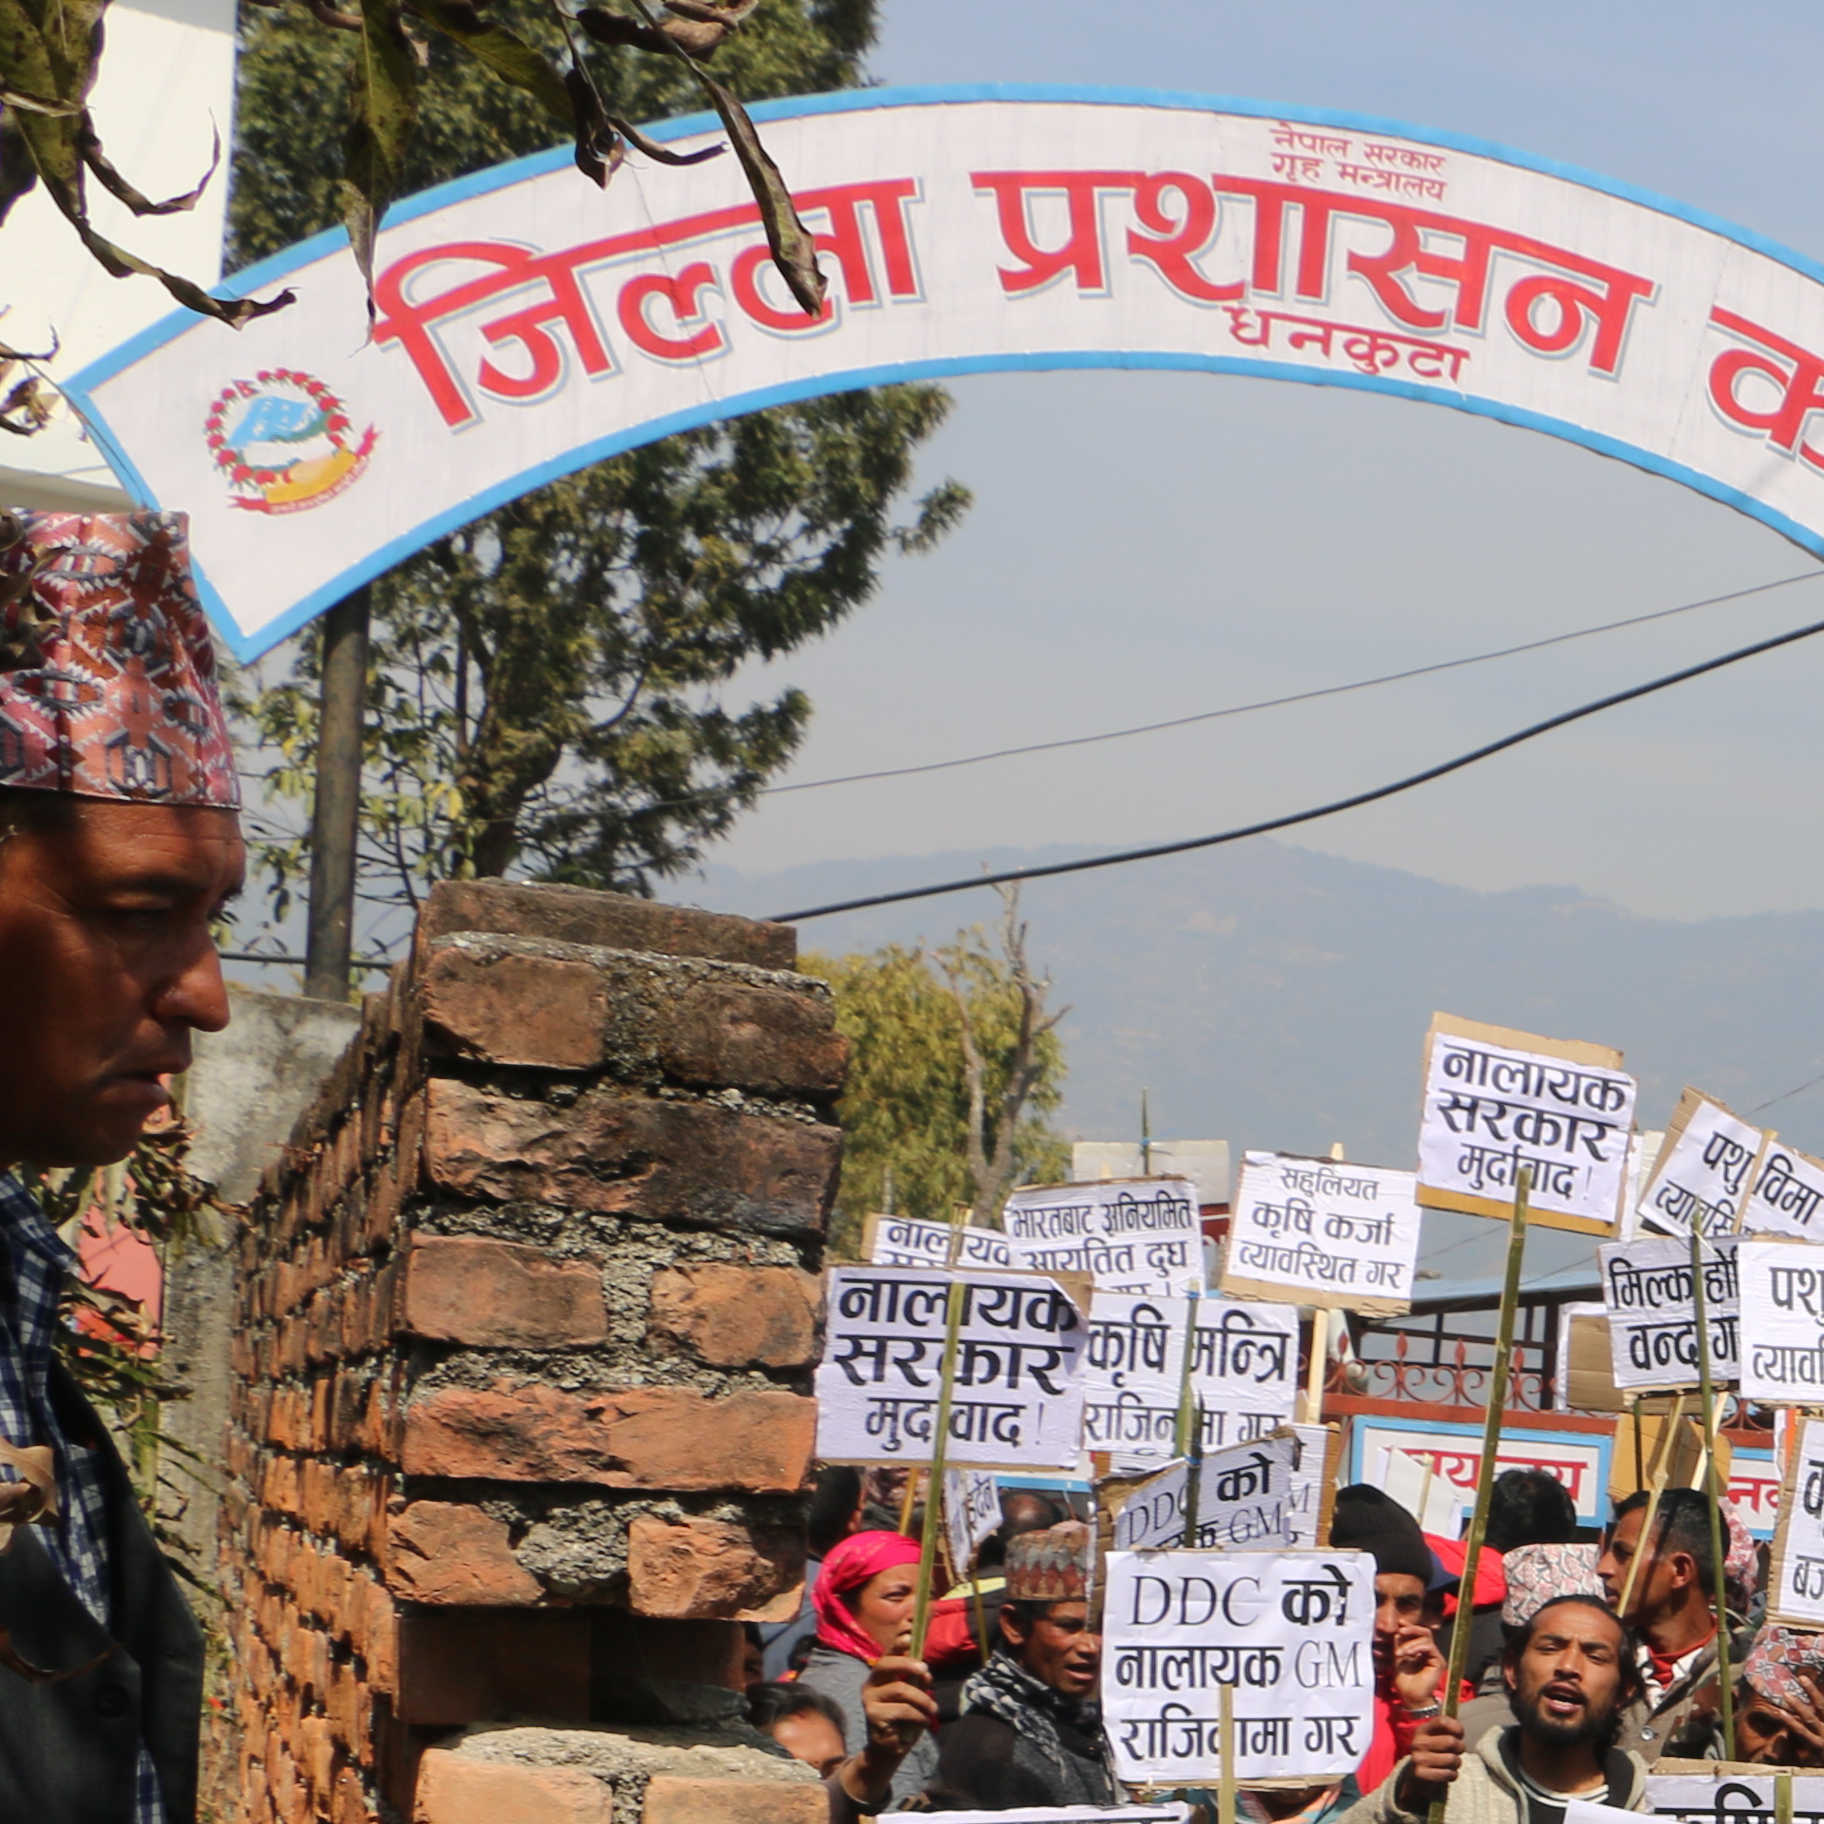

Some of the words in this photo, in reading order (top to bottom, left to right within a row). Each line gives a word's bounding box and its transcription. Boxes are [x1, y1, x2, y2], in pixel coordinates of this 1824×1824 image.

[1270, 121, 1352, 159] नेपाल
[1364, 141, 1447, 175] सरकार
[1272, 152, 1324, 183] गृह
[1338, 161, 1447, 202] मन्त्रालय
[371, 176, 924, 434] जिल्ला
[972, 166, 1656, 378] प्रशासन
[1221, 306, 1471, 383] धनकुटा
[1443, 1044, 1633, 1112] नालायक
[1437, 1087, 1616, 1162] सरकार
[1280, 1167, 1380, 1201] सहुलियत
[1101, 1190, 1192, 1237] अनियमित
[1251, 1196, 1313, 1240] कृषि
[1325, 1204, 1395, 1245] कर्जा
[1145, 1241, 1188, 1277] दुध
[1364, 1260, 1405, 1289] गर
[1609, 1256, 1693, 1311] मिल्क
[839, 1277, 1079, 1334] नालायक
[1088, 1303, 1170, 1387] कृषि
[1131, 1574, 1260, 1628] DDC
[1280, 1563, 1353, 1627] को
[1114, 1644, 1286, 1689] नालायक
[1293, 1640, 1363, 1691] GM
[1303, 1715, 1360, 1758] गर
